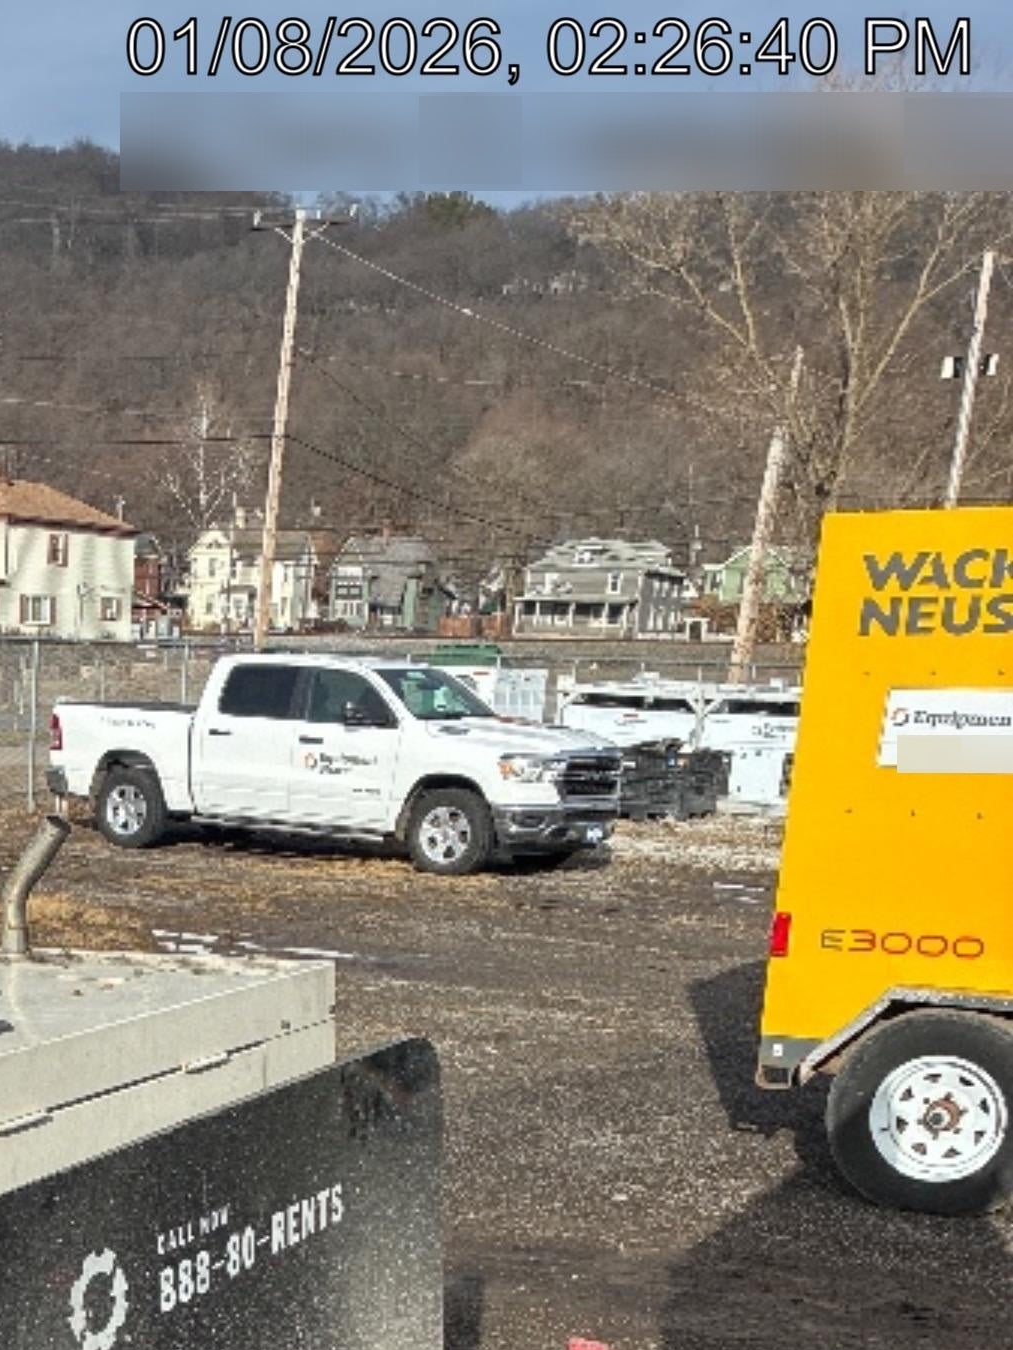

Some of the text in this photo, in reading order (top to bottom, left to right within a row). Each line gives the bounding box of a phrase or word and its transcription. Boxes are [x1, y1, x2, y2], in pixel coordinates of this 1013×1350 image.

[821, 929, 984, 959] E3000
[157, 1203, 230, 1256] CALL NOW
[159, 1184, 344, 1313] 888-80-RENTS
